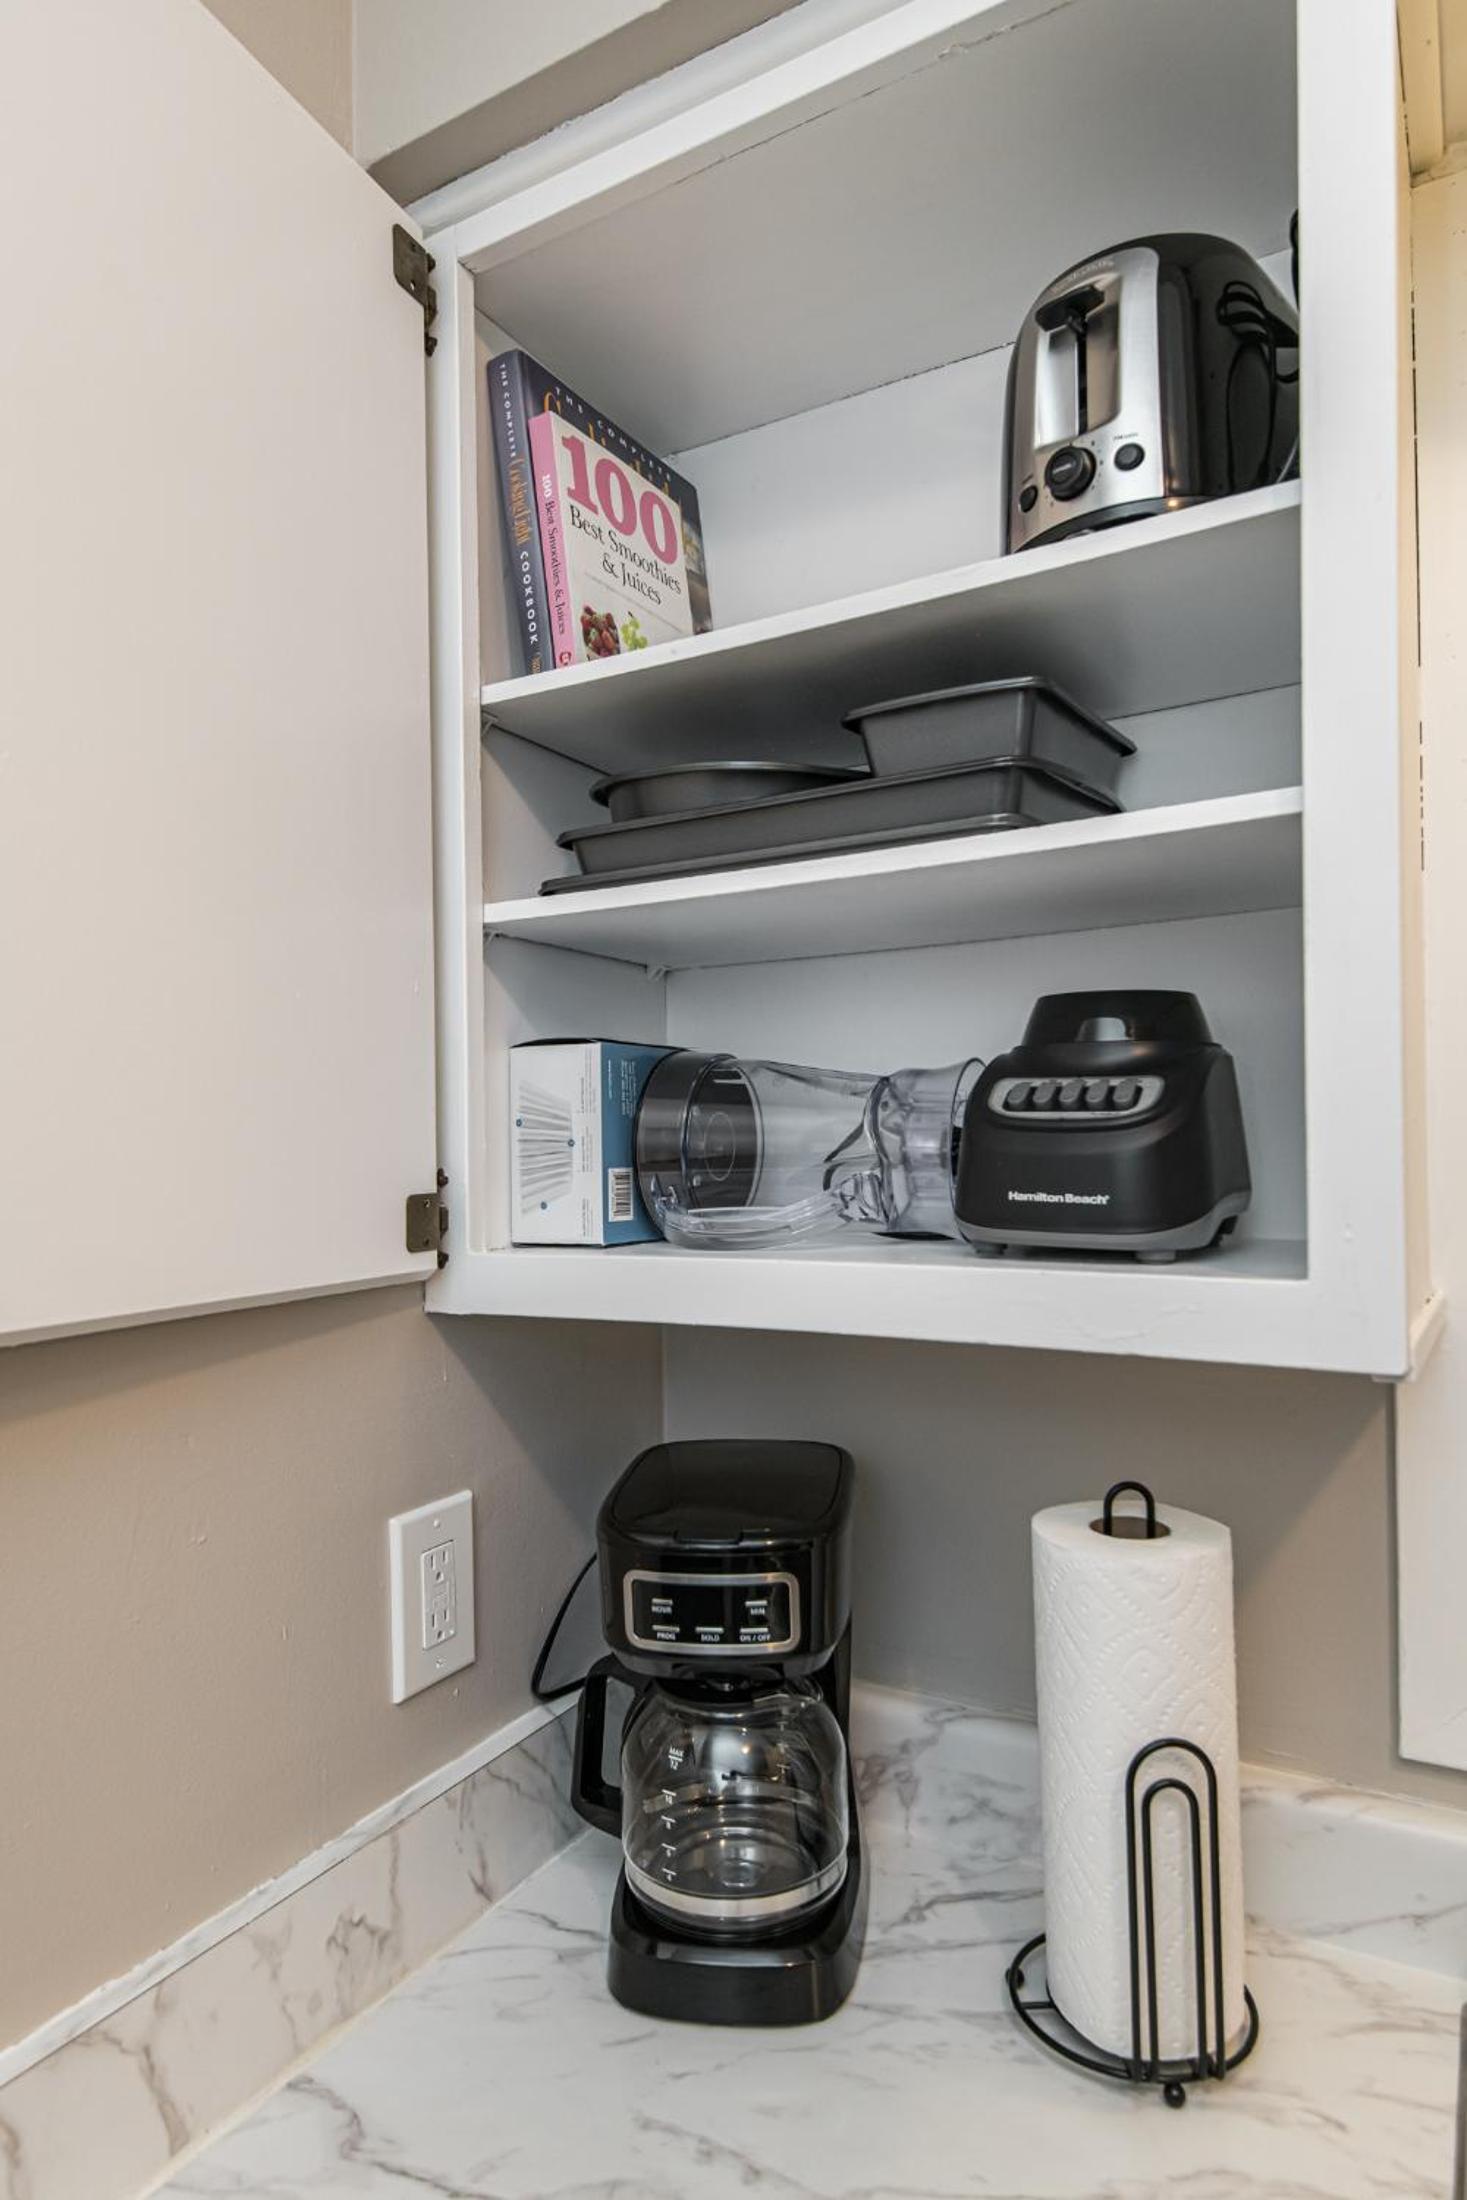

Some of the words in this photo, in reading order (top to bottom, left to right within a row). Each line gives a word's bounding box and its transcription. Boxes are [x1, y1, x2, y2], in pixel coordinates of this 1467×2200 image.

[541, 473, 553, 499] 100
[561, 434, 679, 565] 100
[570, 503, 605, 545] Best
[608, 529, 682, 595] Smoothies
[602, 552, 619, 579] &
[620, 562, 662, 605] Juices
[520, 550, 538, 645] COOKBOOK
[1007, 1190, 1064, 1203] Hamilton
[1064, 1193, 1108, 1205] Beach
